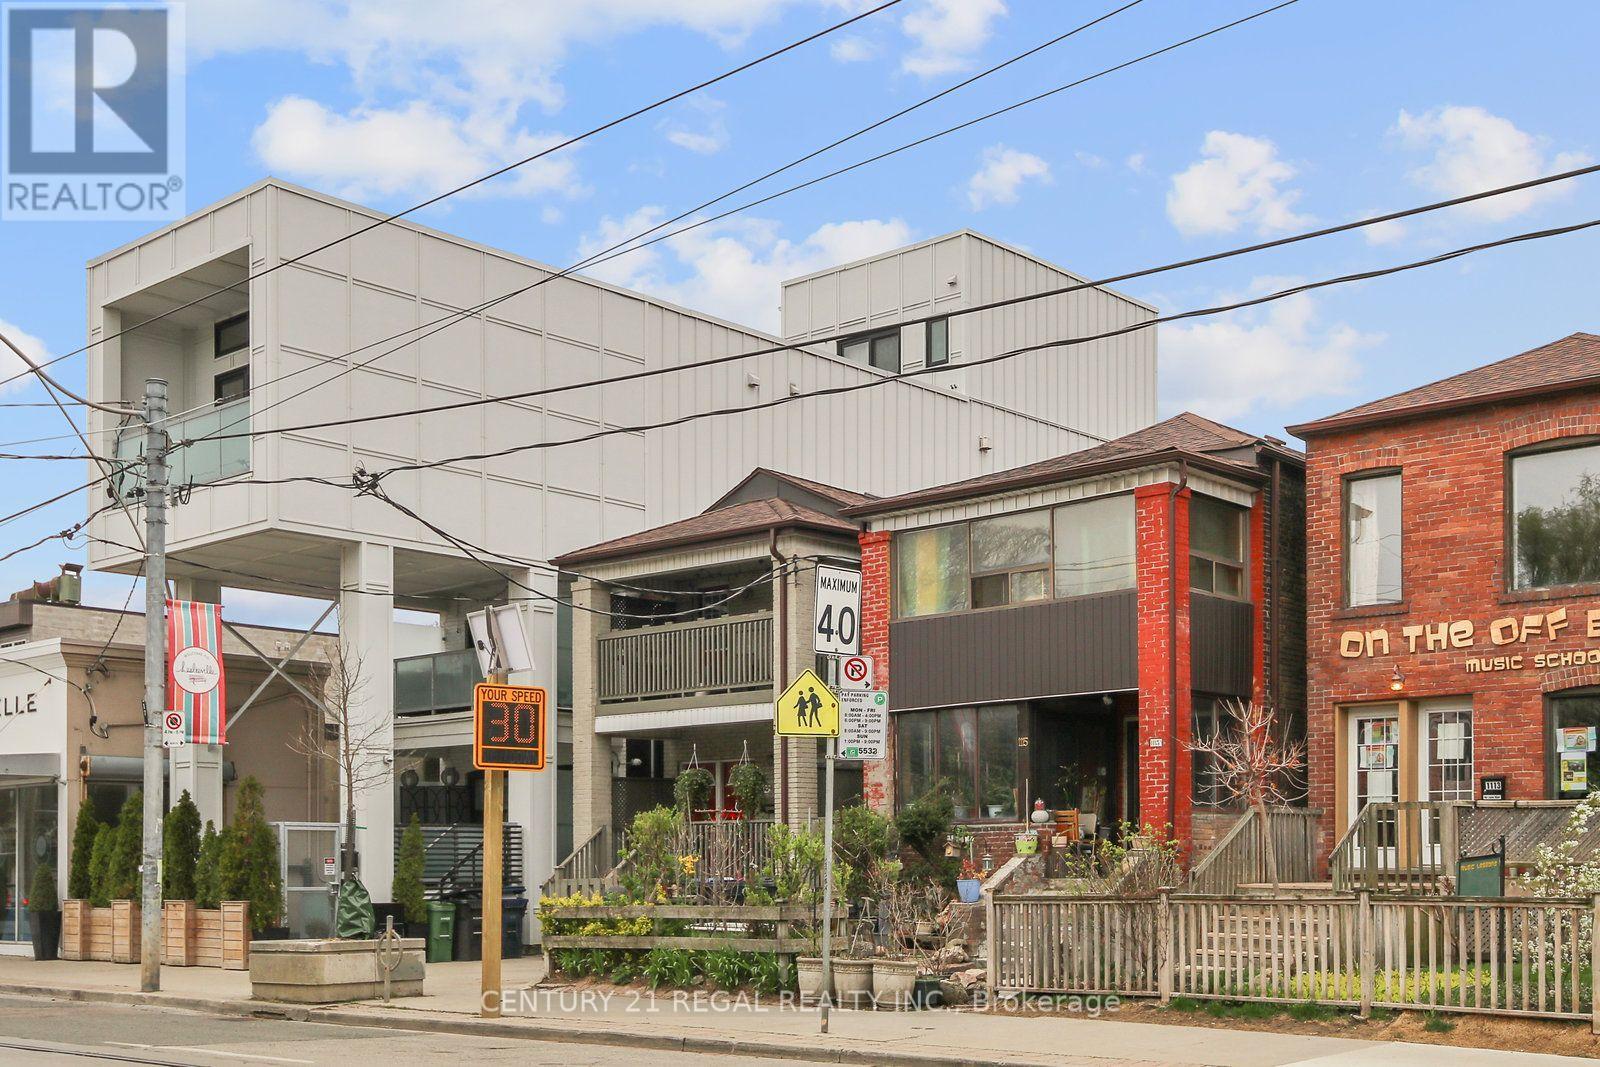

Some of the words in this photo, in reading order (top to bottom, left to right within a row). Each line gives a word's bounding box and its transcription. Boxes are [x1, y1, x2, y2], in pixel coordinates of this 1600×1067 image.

[820, 576, 858, 594] MAXIMUM
[817, 604, 856, 645] 40
[1490, 606, 1569, 646] OFF
[0, 693, 37, 716] LLE
[481, 689, 507, 701] YOUR
[511, 691, 542, 703] SPEED
[491, 703, 535, 743] 30
[858, 747, 878, 755] 5532
[1486, 781, 1501, 790] 1113
